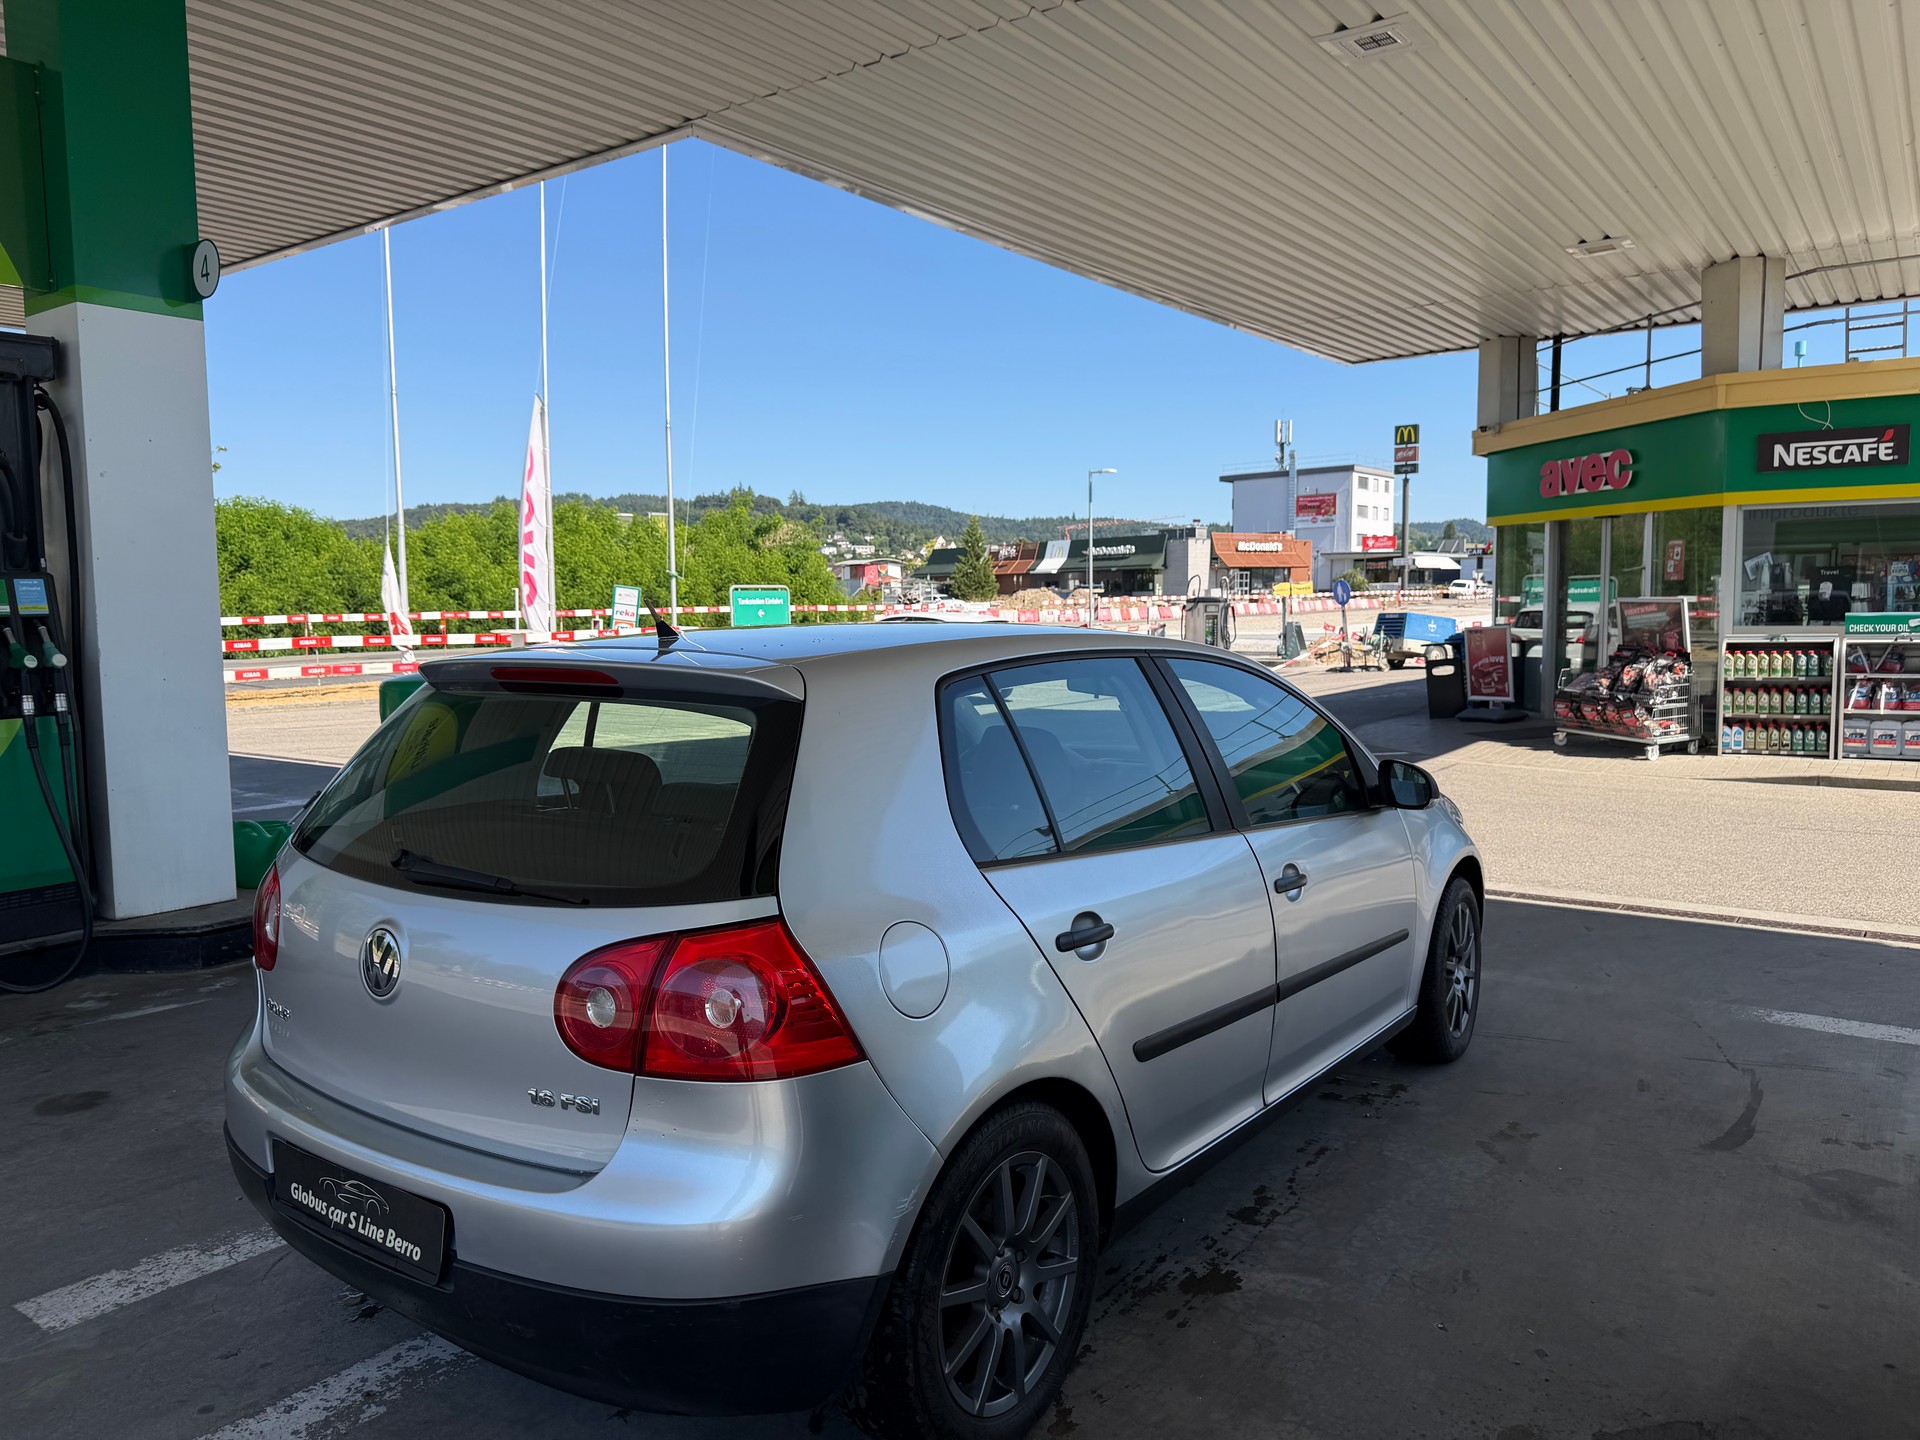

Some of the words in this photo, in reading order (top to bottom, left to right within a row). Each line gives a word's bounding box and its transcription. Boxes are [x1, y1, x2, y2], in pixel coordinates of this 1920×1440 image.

[200, 253, 210, 283] 4
[1540, 448, 1633, 498] avec
[615, 609, 635, 617] reka
[1848, 624, 1874, 633] CHECK
[1875, 624, 1897, 633] YOUR
[1897, 623, 1911, 632] OIL
[1489, 655, 1505, 663] love
[560, 1093, 600, 1116] FSI
[290, 1182, 327, 1216] Globus
[328, 1205, 348, 1226] car
[348, 1211, 357, 1230] S
[358, 1215, 384, 1244] Line
[385, 1228, 422, 1262] Berro
